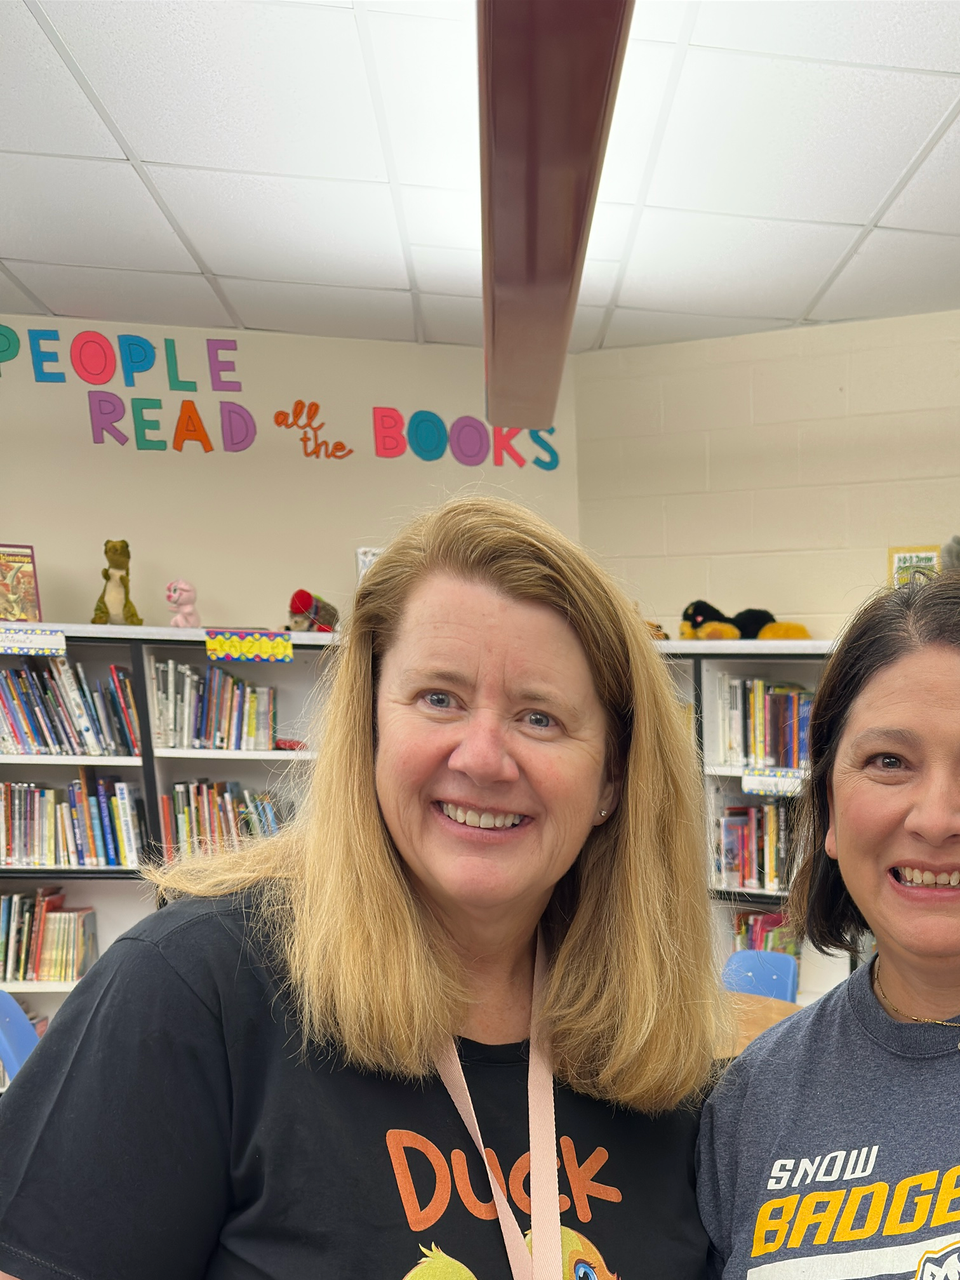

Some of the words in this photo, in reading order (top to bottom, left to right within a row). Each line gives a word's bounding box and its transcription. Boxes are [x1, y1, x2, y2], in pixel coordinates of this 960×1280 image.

[0, 325, 242, 392] PEOPLE
[88, 391, 257, 453] READ
[274, 400, 324, 431] all
[301, 431, 353, 460] the
[373, 407, 560, 471] BOOKS
[767, 1145, 880, 1190] SNOW
